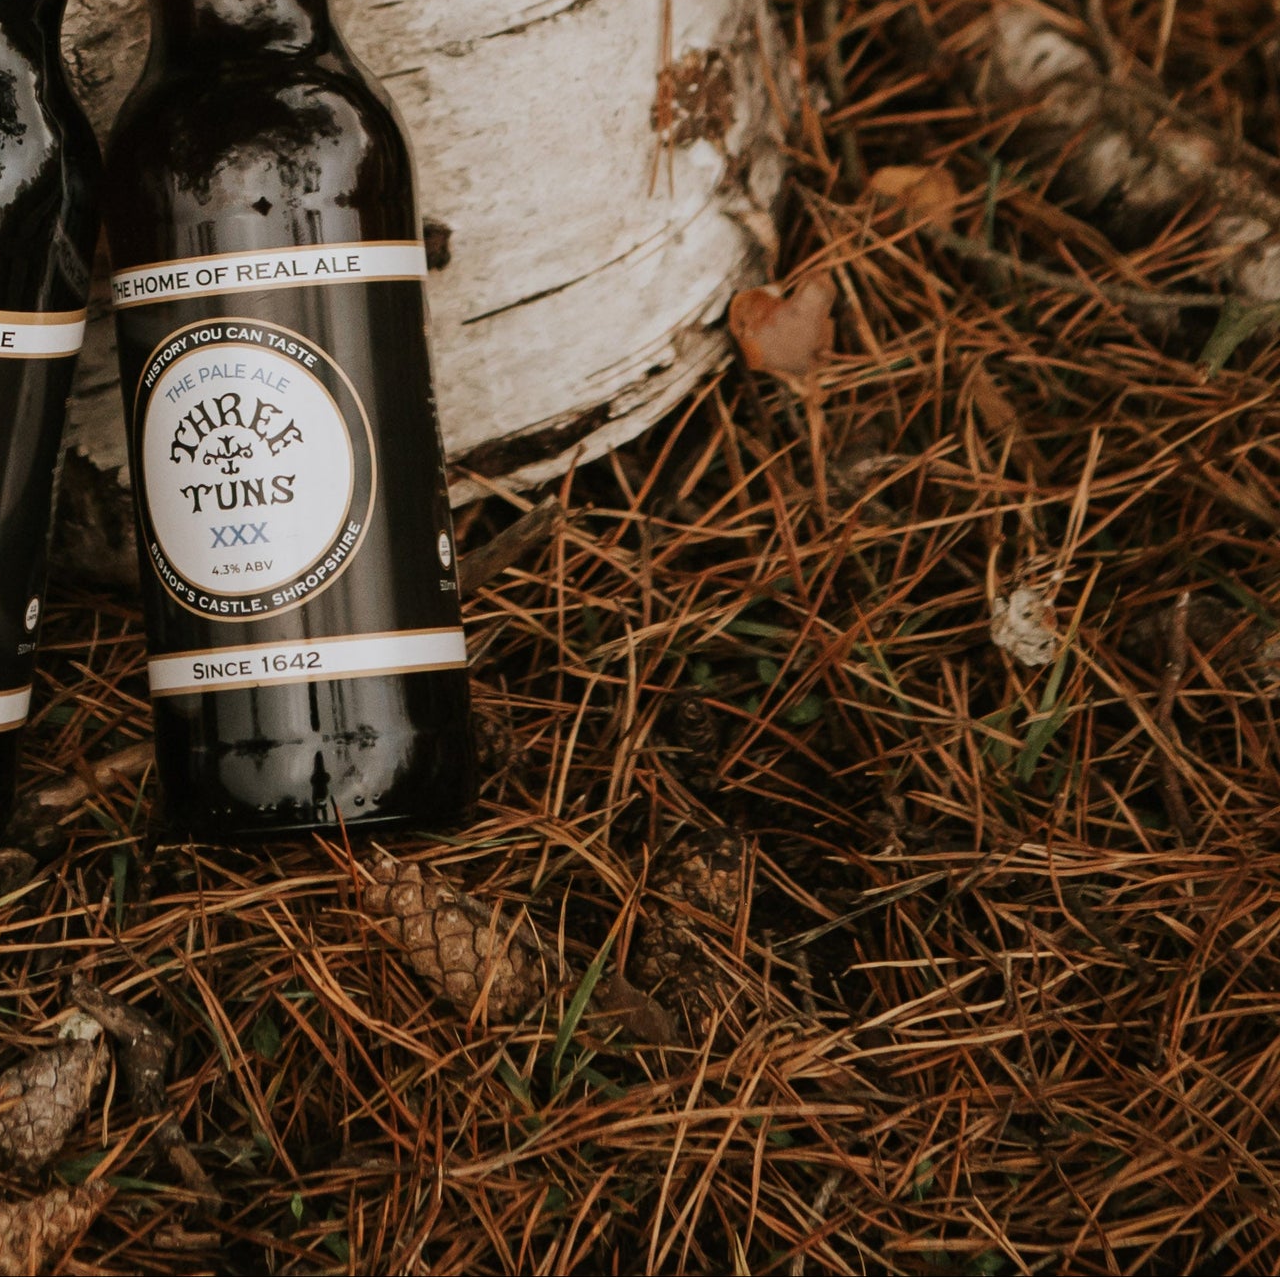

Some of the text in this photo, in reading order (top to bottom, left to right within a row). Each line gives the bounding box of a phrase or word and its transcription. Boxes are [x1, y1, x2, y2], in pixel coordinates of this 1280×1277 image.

[134, 272, 190, 296] HOME
[196, 267, 229, 286] OF
[236, 260, 308, 282] REAL
[314, 256, 361, 275] ALE
[144, 327, 318, 388] HISTORY YOU CAN TASTE
[165, 363, 291, 404] THE PALE ALE
[169, 392, 304, 463] THREE
[180, 474, 296, 513] TUNS
[210, 522, 270, 548] XXX
[151, 543, 196, 602] BISHOP'S
[272, 520, 361, 606] SHROPSHIRE
[211, 560, 273, 575] 4.3% ABV
[261, 652, 322, 672] 1642
